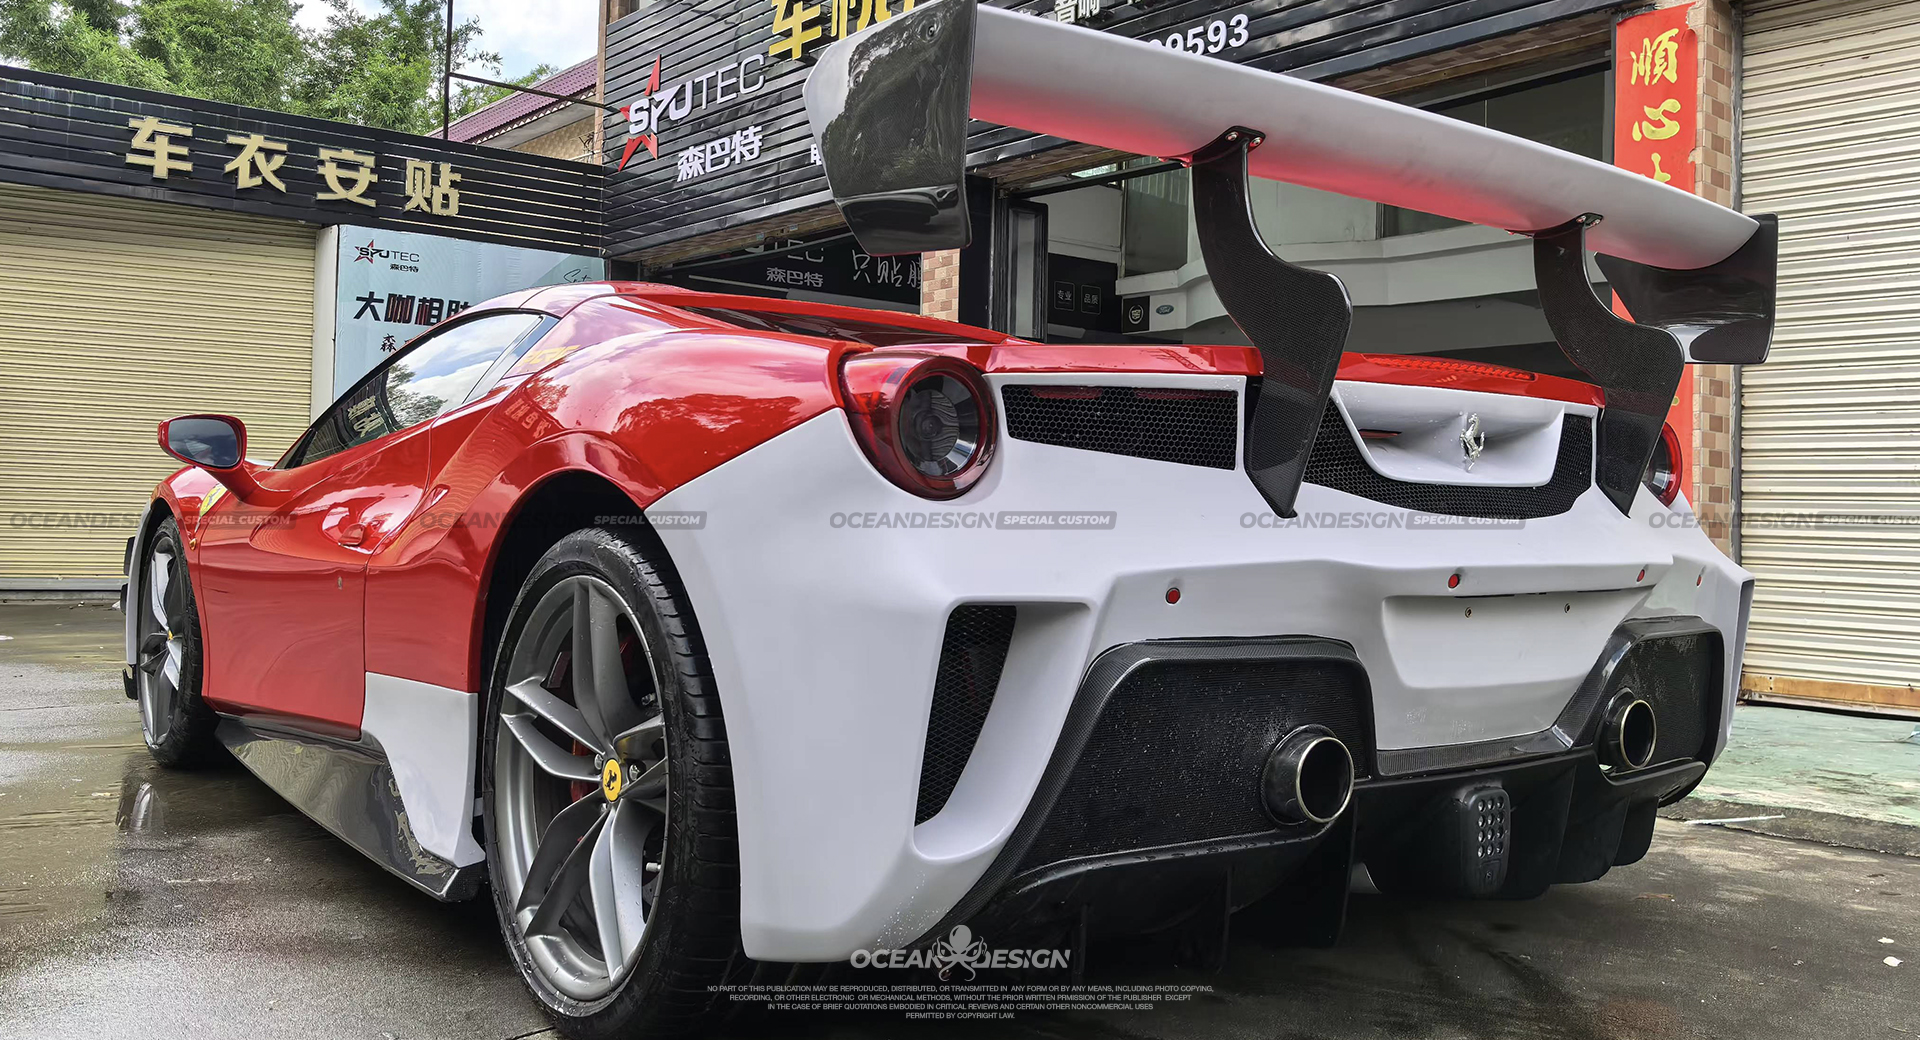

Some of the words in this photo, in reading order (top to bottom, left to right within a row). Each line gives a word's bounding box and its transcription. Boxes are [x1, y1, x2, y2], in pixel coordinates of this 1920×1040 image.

[1148, 13, 1249, 55] 9593
[125, 116, 462, 216] 车衣安贴
[677, 126, 763, 182] 森巴特
[766, 267, 824, 288] 森巴特
